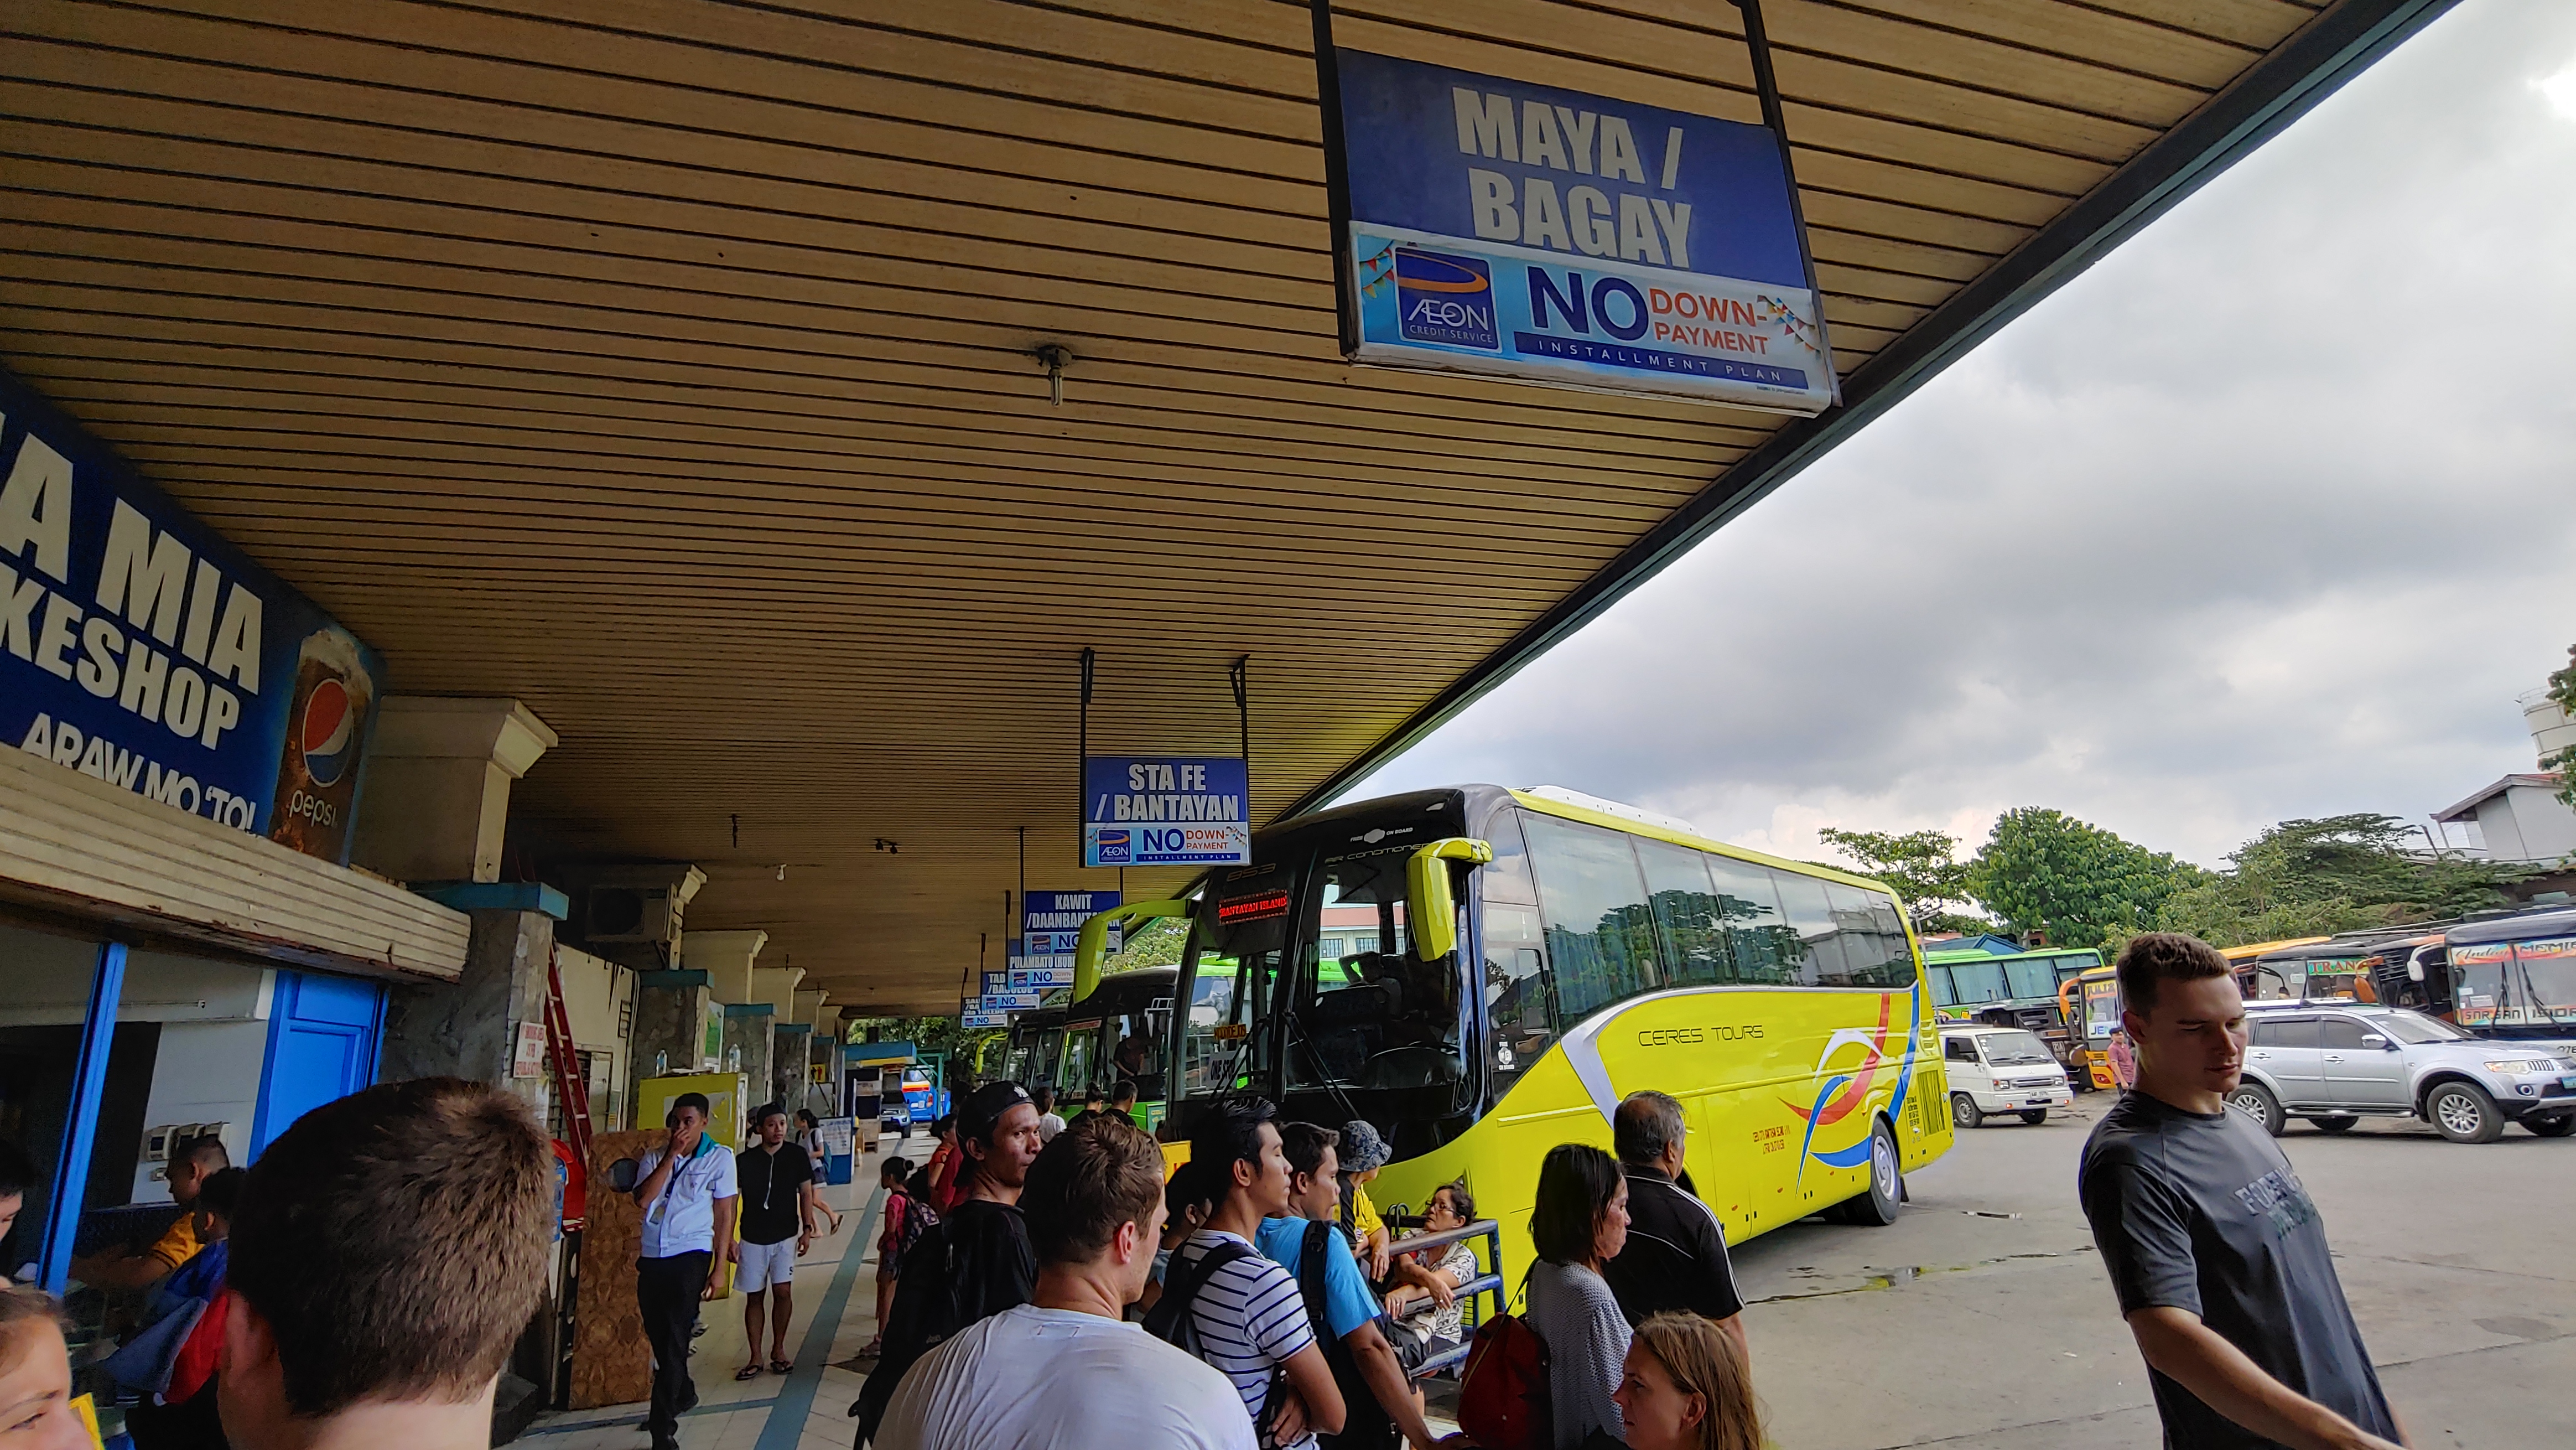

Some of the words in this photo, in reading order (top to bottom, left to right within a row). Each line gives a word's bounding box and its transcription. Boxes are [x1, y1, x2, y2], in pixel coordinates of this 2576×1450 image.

[1451, 86, 1645, 184] MAYA
[1661, 127, 1684, 190] /
[1468, 167, 1691, 268] BAGAY
[1527, 266, 1649, 341] NO
[1649, 288, 1768, 328] DOWN-
[1410, 324, 1447, 338] CREDIT
[1450, 329, 1493, 343] SERVICE
[1653, 321, 1768, 355] PAYMENT
[1539, 340, 1707, 372] INSTALLMENT
[1725, 365, 1781, 381] PLAN
[0, 411, 74, 585] A
[95, 496, 263, 696] MIA
[20, 712, 144, 791] ARAW
[144, 760, 200, 815] MO
[1129, 764, 1176, 791] STA
[1181, 765, 1207, 791] FE
[289, 789, 337, 828] pepsi
[1094, 794, 1108, 821] /
[1114, 794, 1239, 821] BANTAYAN
[1142, 828, 1185, 852] NO
[1186, 830, 1229, 840] DOWN-
[1186, 842, 1229, 850] PAYMENT
[1055, 894, 1093, 910] KAWIT
[1219, 902, 1258, 917] BANTAYAN
[1259, 897, 1287, 910] ISLAND
[1010, 956, 1053, 969] PULAMBATO
[1033, 971, 1053, 982] NO
[1001, 997, 1017, 1005] NO
[1638, 1028, 1704, 1047] CERES
[1711, 1025, 1764, 1042] TOURS
[1211, 1059, 1222, 1080] ONE
